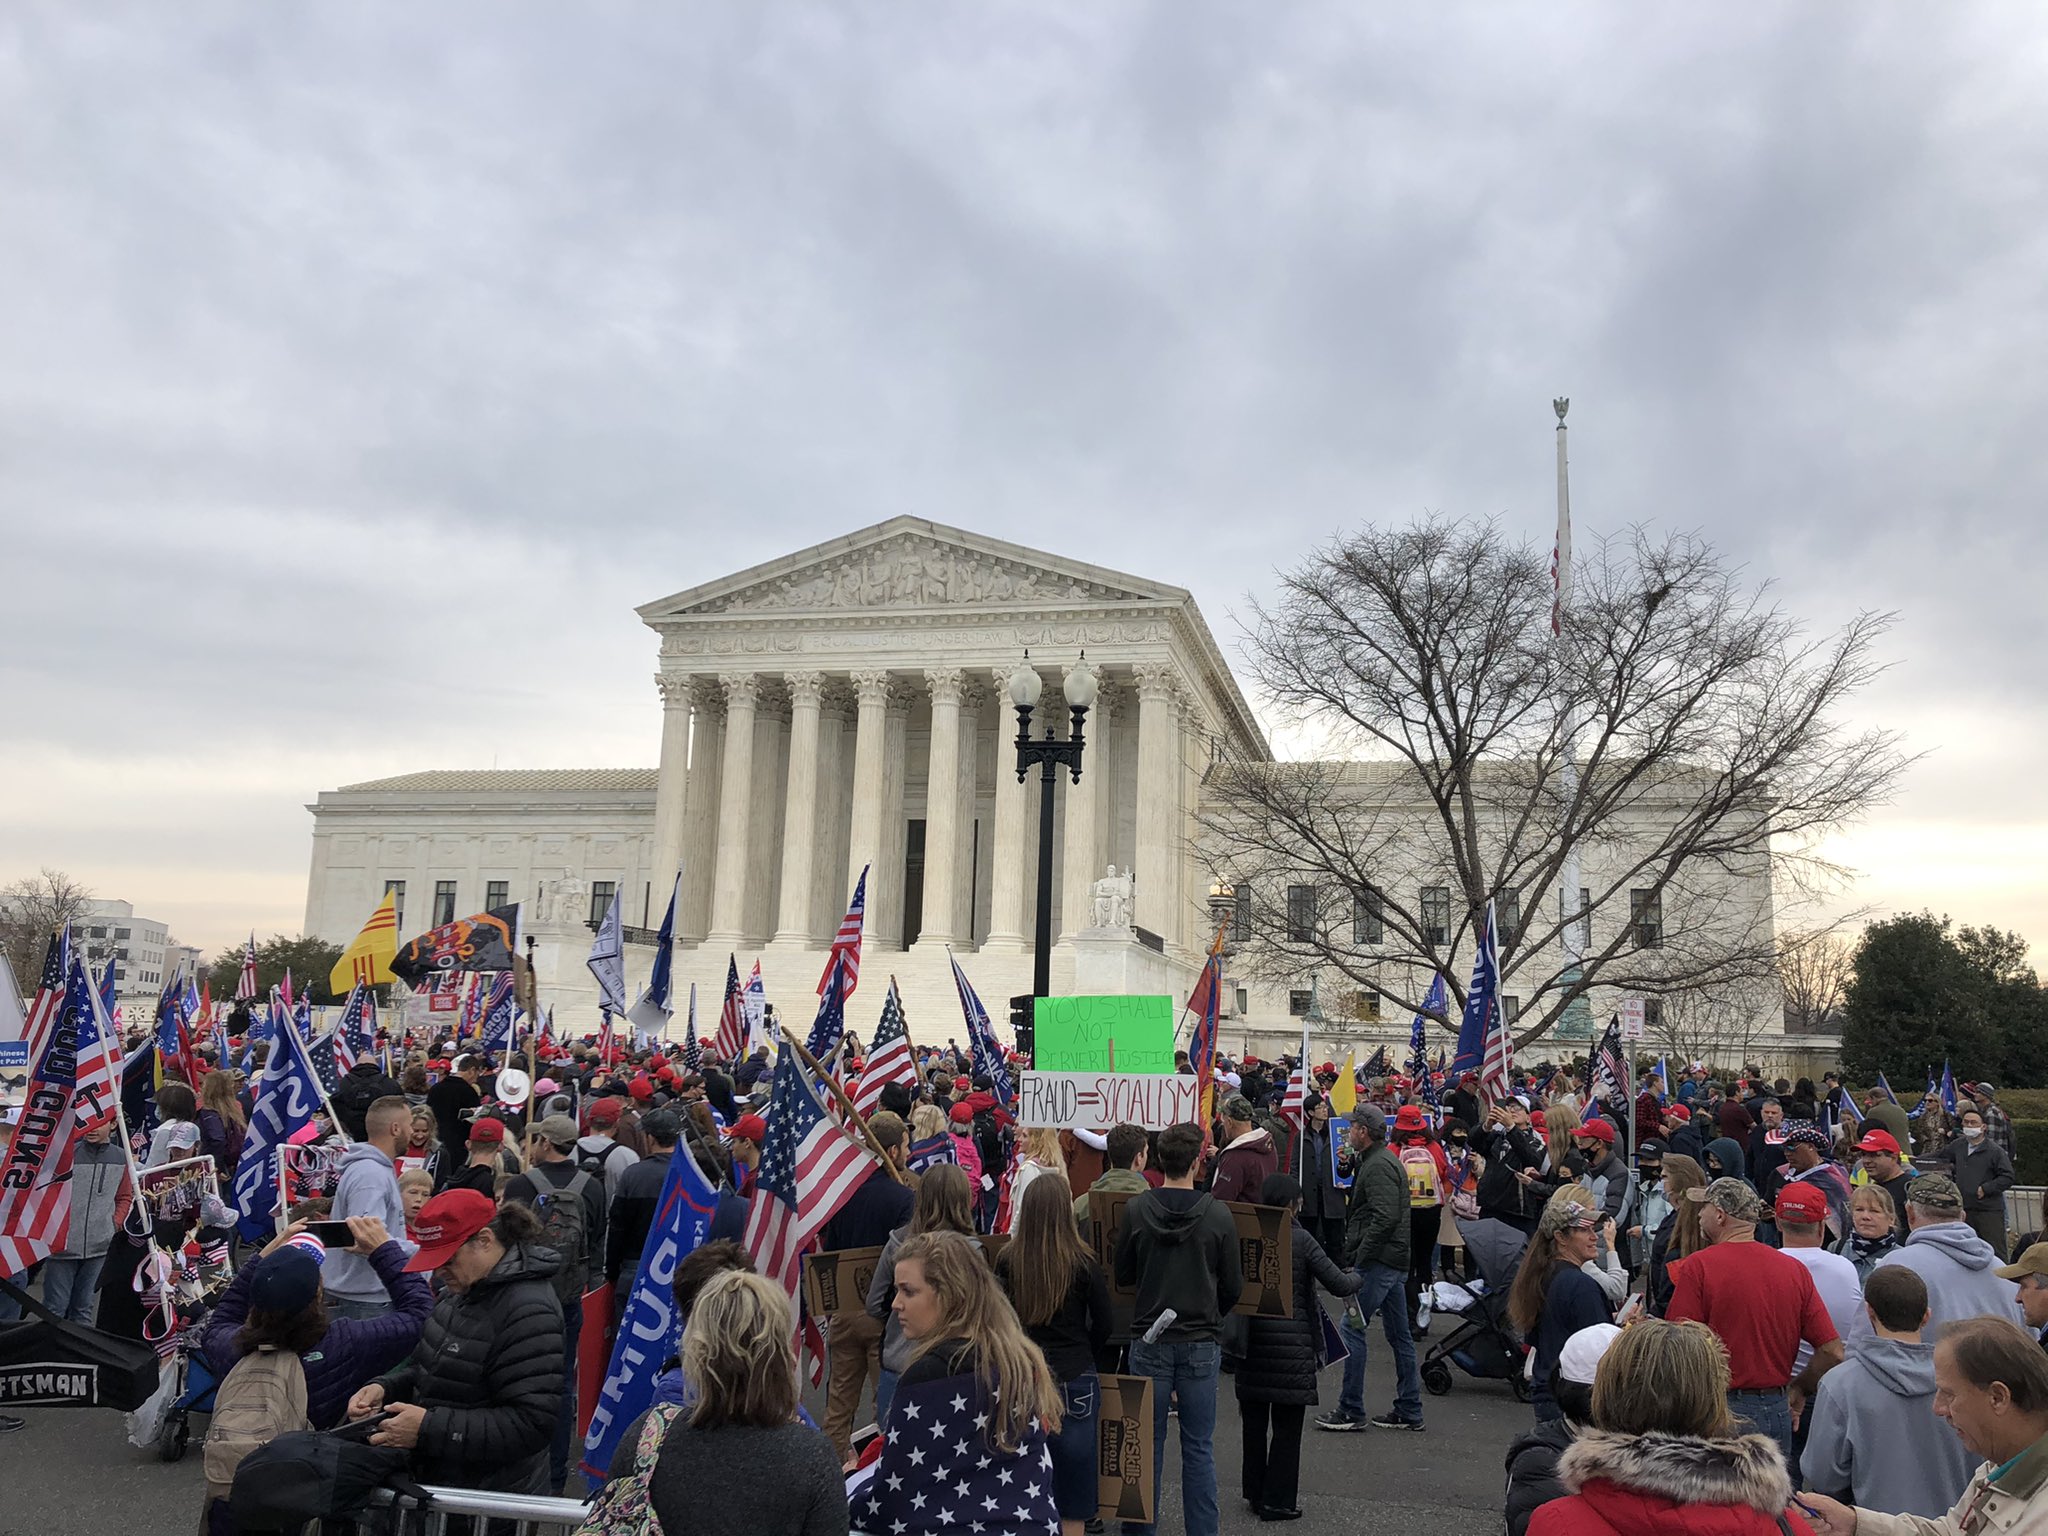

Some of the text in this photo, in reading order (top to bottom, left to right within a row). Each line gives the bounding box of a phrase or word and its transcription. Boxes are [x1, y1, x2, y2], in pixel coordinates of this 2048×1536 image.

[813, 631, 1005, 647] EQUAL JUSTICE UNDER LAW
[1042, 997, 1172, 1024] YOU SHALL
[1073, 1021, 1115, 1045] NOT
[1035, 1047, 1174, 1071] PERVERT JUSTICE
[1782, 1202, 1806, 1210] TRUMP
[1248, 1242, 1257, 1279] TRIFOLD
[1263, 1236, 1281, 1290] ArtSkills
[0, 1373, 87, 1398] FTSMAN
[1108, 1425, 1117, 1472] TRIFOLD
[1123, 1417, 1140, 1485] ArtSkills
